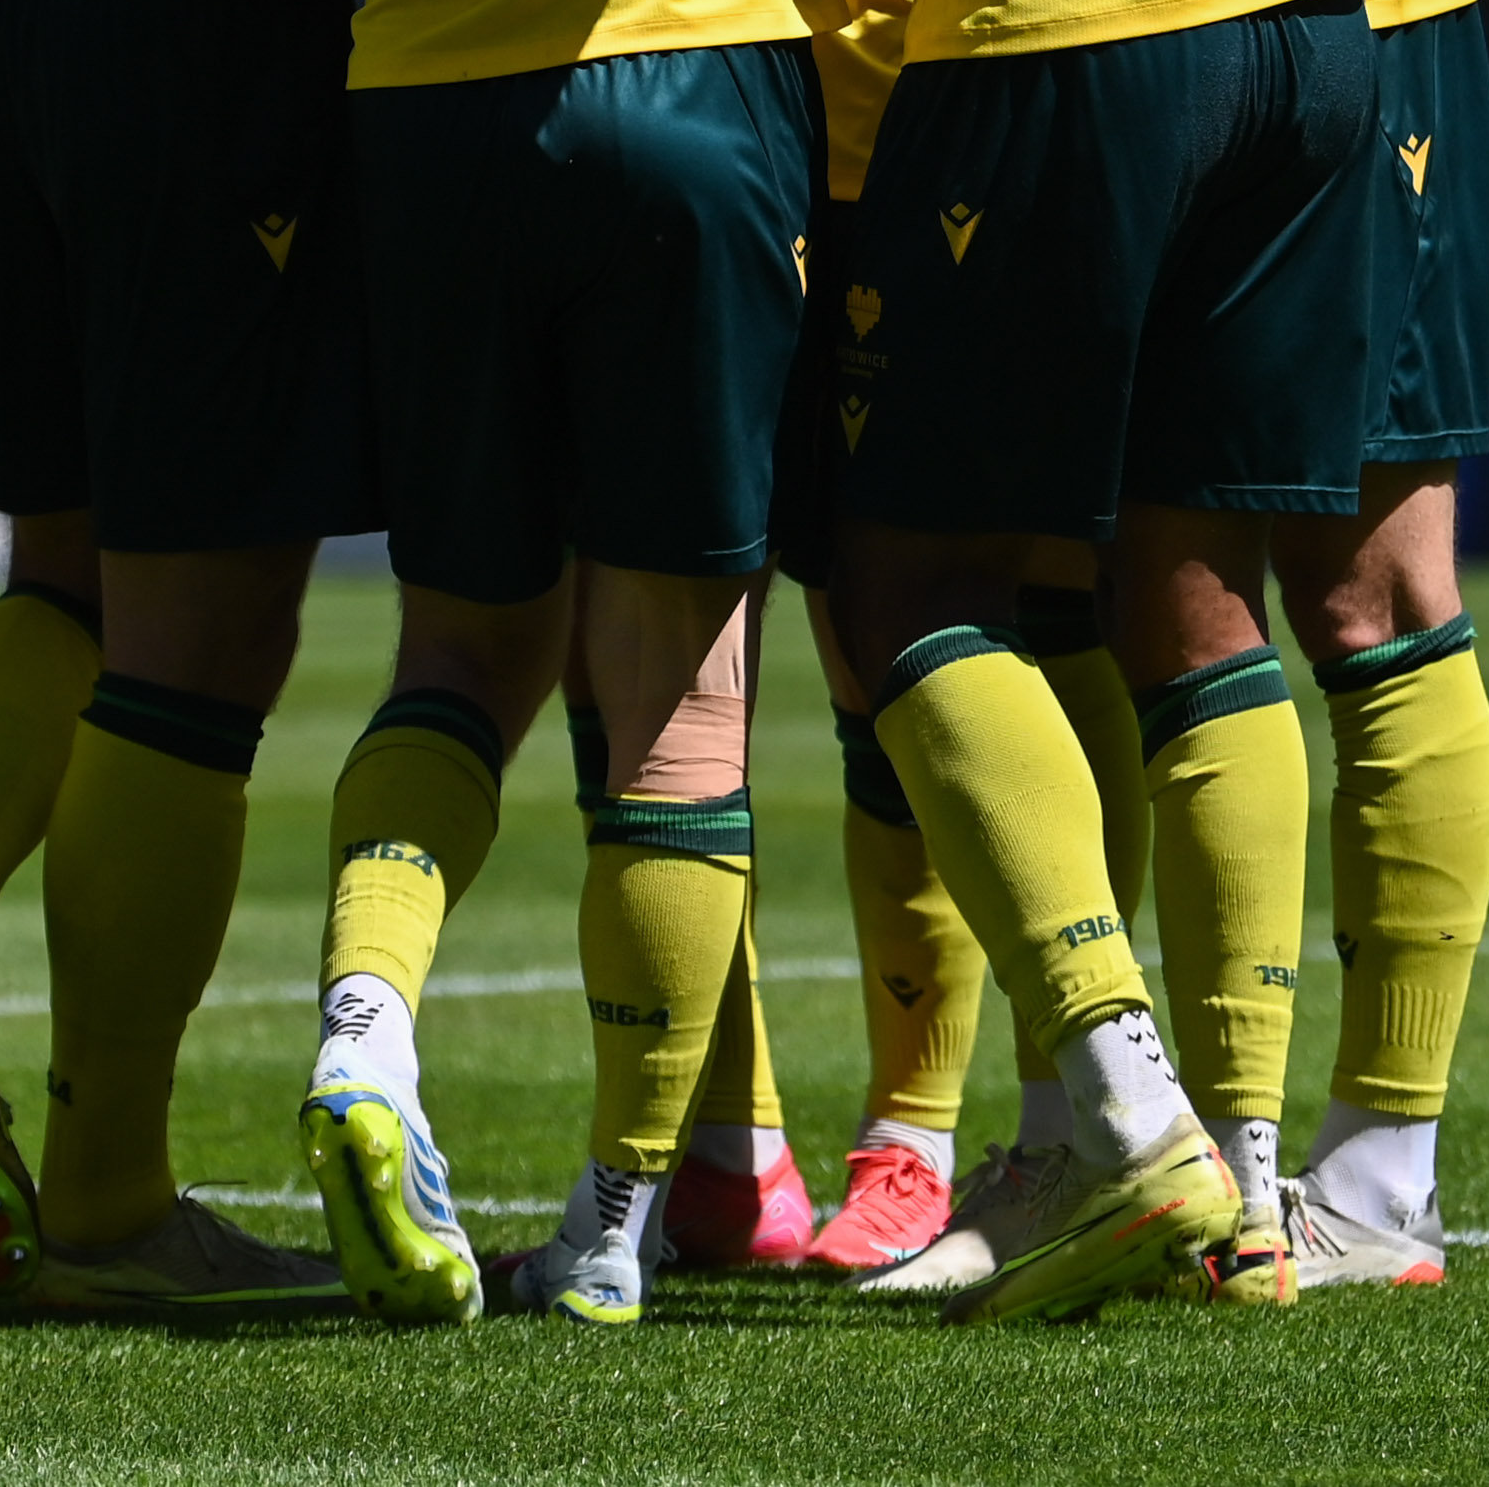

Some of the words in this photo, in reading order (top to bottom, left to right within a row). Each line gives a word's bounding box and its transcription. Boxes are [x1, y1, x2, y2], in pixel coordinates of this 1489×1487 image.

[340, 837, 438, 879] 1964
[1056, 912, 1128, 952] 1964
[587, 996, 670, 1030] 1964
